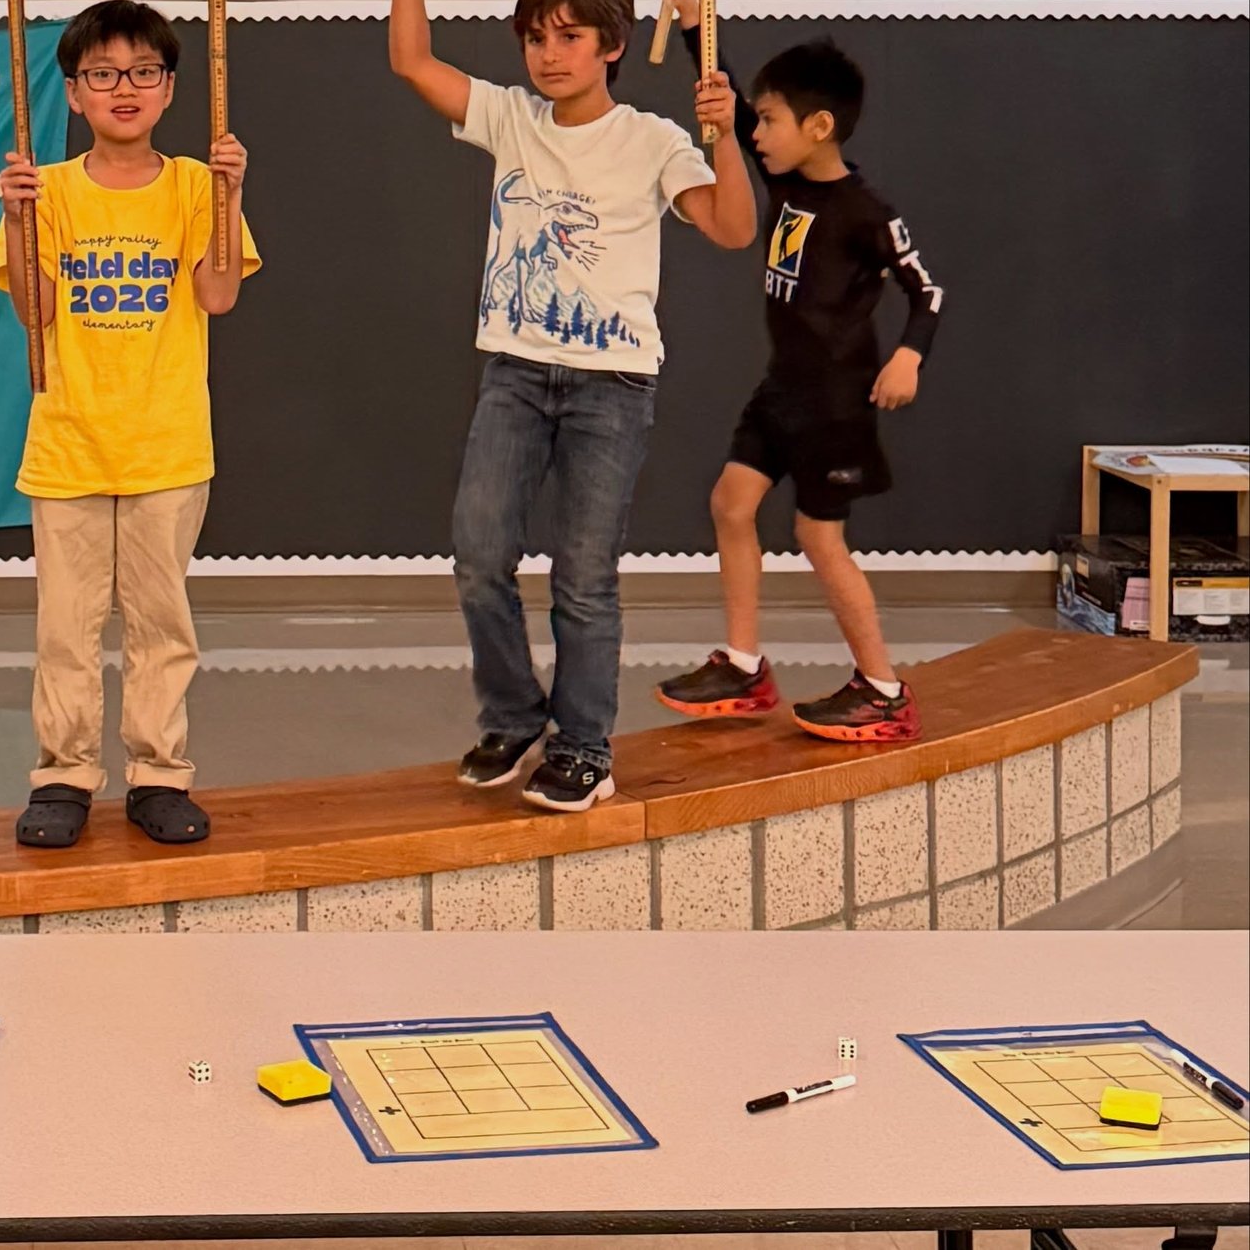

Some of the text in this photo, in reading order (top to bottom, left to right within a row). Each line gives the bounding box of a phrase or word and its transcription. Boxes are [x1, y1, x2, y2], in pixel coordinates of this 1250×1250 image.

[73, 234, 163, 251] happy valley
[765, 269, 798, 303] BTT
[69, 283, 170, 314] 2026
[82, 317, 157, 332] elementary
